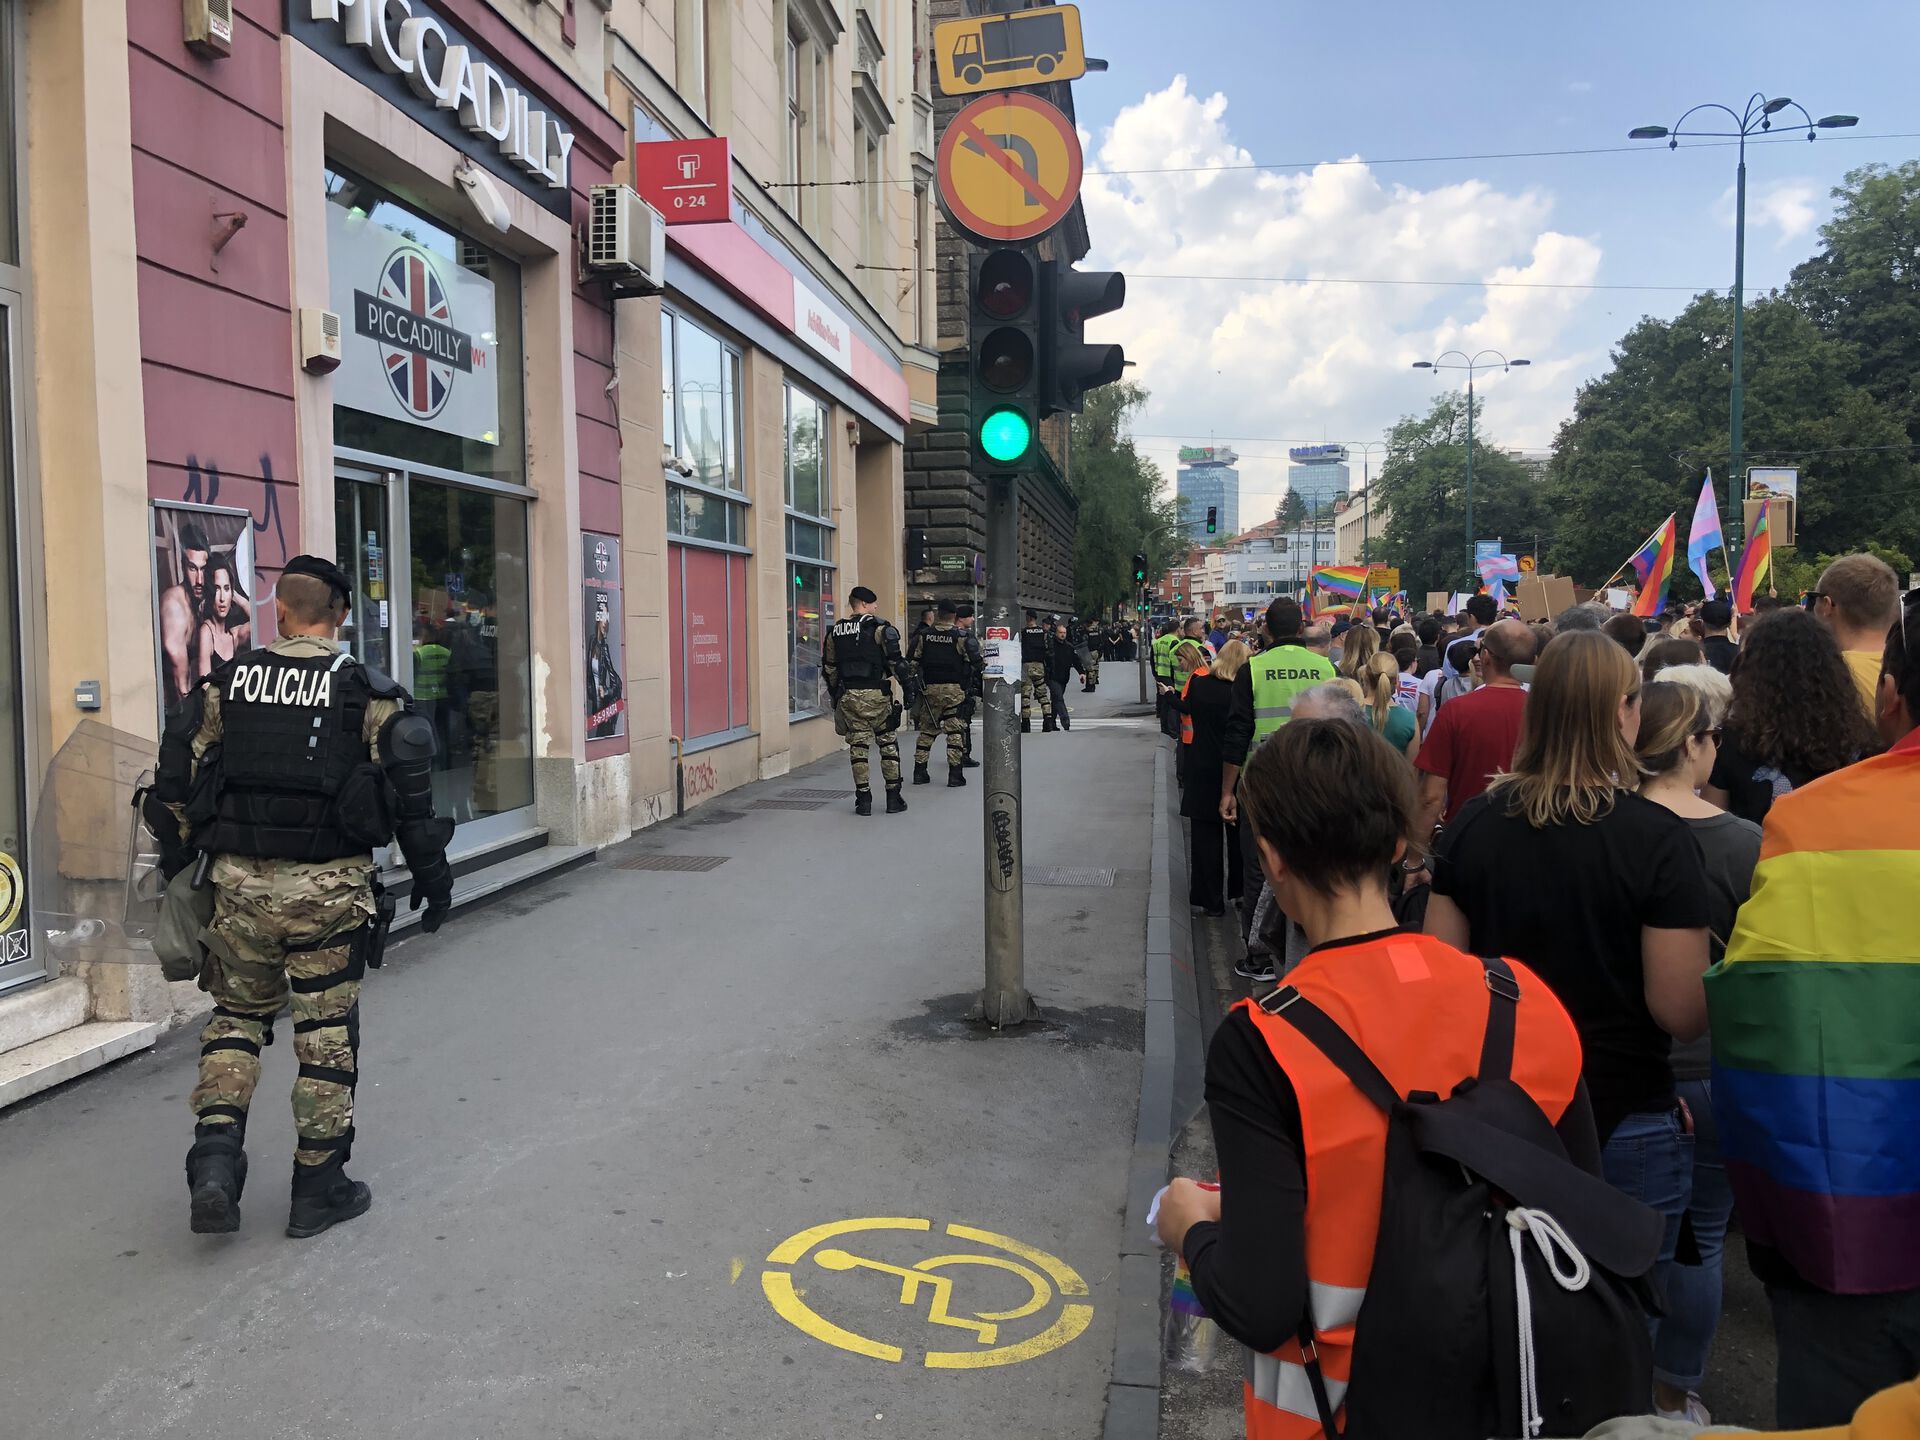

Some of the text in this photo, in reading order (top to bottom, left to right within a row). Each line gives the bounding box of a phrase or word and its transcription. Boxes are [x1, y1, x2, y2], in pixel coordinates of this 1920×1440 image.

[368, 303, 486, 369] PICCADILLY W1
[832, 621, 861, 637] POLICIJA
[926, 634, 953, 643] POLICIJA
[1265, 668, 1321, 681] REDAR
[229, 664, 331, 708] POLICIJA
